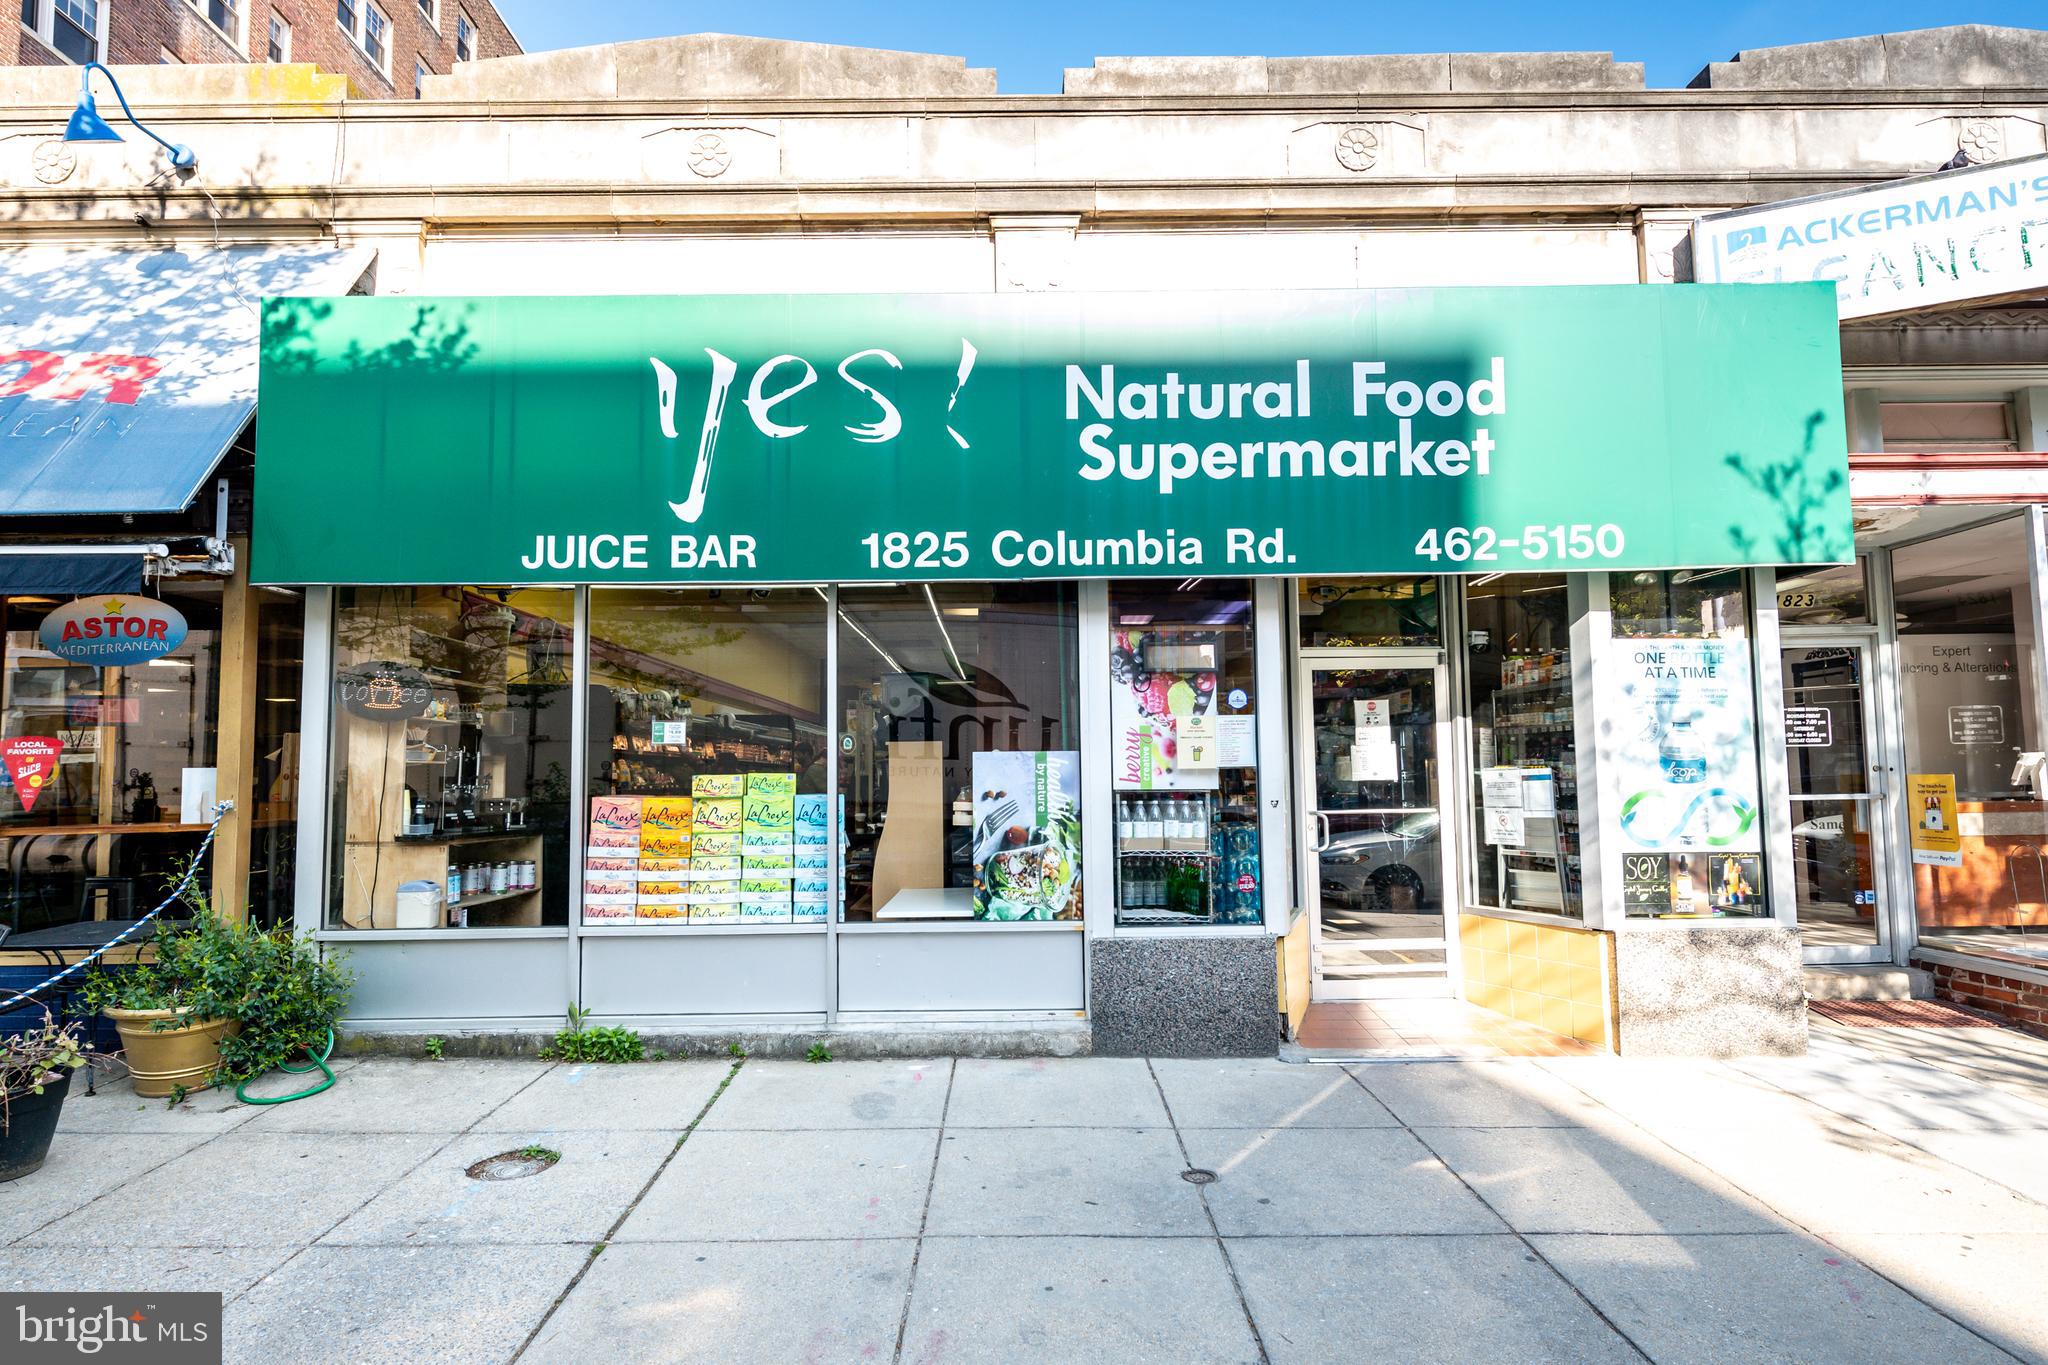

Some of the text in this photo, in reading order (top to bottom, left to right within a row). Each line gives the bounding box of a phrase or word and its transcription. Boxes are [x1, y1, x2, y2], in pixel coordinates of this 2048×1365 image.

[1066, 357, 1506, 420] Natural Food
[650, 337, 977, 523] yes!
[1078, 419, 1495, 494] Supermarket
[521, 534, 757, 569] JUICE BAR
[862, 527, 1298, 569] 1825 Columbia Rd.
[1415, 522, 1625, 562] 462-5150
[61, 617, 169, 642] ASTOR
[56, 641, 170, 656] MEDITERRANEAN
[1634, 652, 1666, 664] ONE
[1932, 646, 1971, 658] Expert
[1644, 666, 1717, 678] AT A TIME
[1943, 662, 1952, 673] &
[1119, 727, 1153, 784] berry
[694, 778, 727, 792] LaCroix
[749, 777, 783, 790] LaCroix
[1035, 763, 1046, 813] by nature
[593, 806, 638, 825] LaCroix
[643, 807, 688, 826] LaCroix
[694, 806, 738, 825] LaCroix
[744, 804, 789, 822] LaCroix
[642, 839, 676, 853] LaCroix
[693, 837, 727, 851] LaCroix
[1625, 856, 1662, 880] SOY
